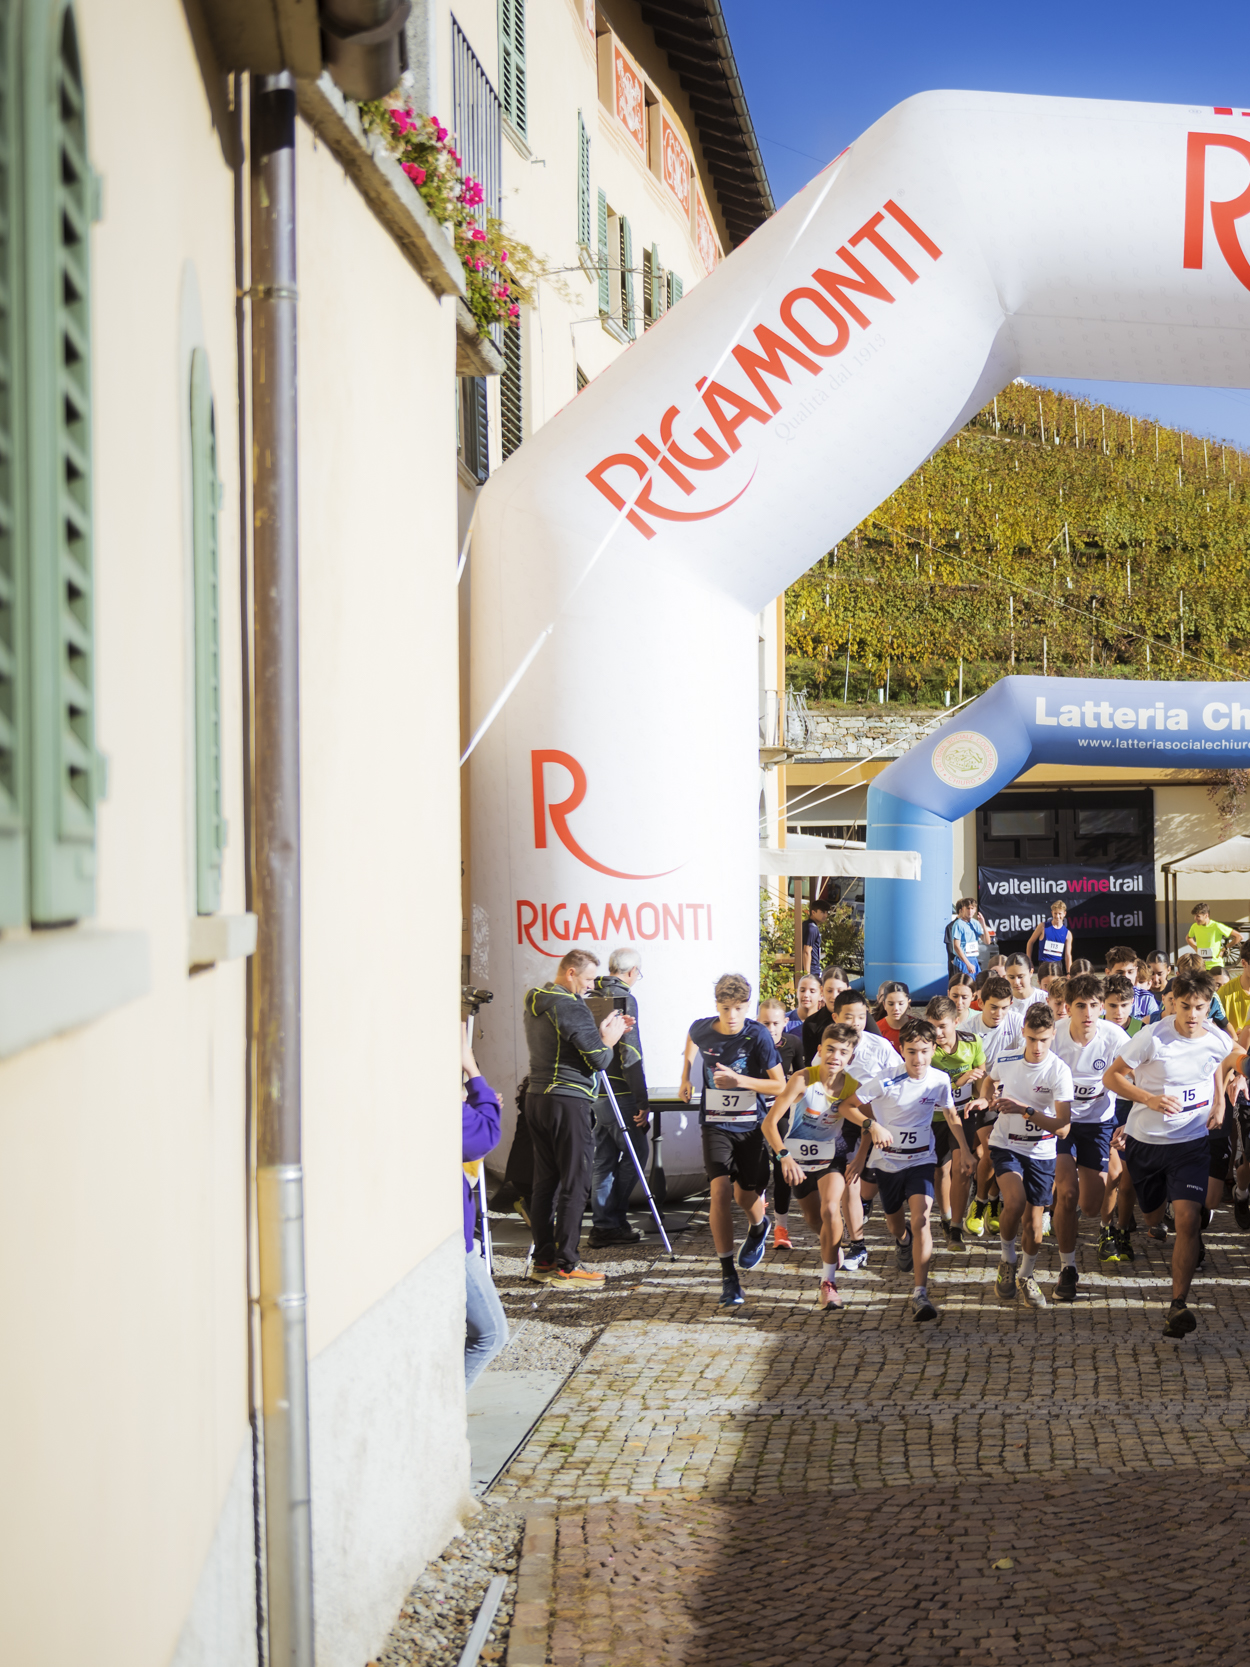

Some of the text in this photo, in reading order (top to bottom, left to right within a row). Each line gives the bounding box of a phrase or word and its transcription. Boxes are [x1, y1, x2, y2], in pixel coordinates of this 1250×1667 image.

[585, 197, 944, 541] RIGAMONTI
[774, 333, 887, 446] Qualità dal 1913
[1035, 696, 1189, 731] Latteria
[530, 749, 690, 881] R
[987, 875, 1143, 895] valtellinawinetrail
[516, 900, 714, 958] RIGAMONTI
[1074, 1085, 1096, 1095] 102
[1183, 1089, 1195, 1102] 15
[722, 1095, 739, 1107] 37
[900, 1132, 917, 1144] 75
[800, 1144, 818, 1156] 96
